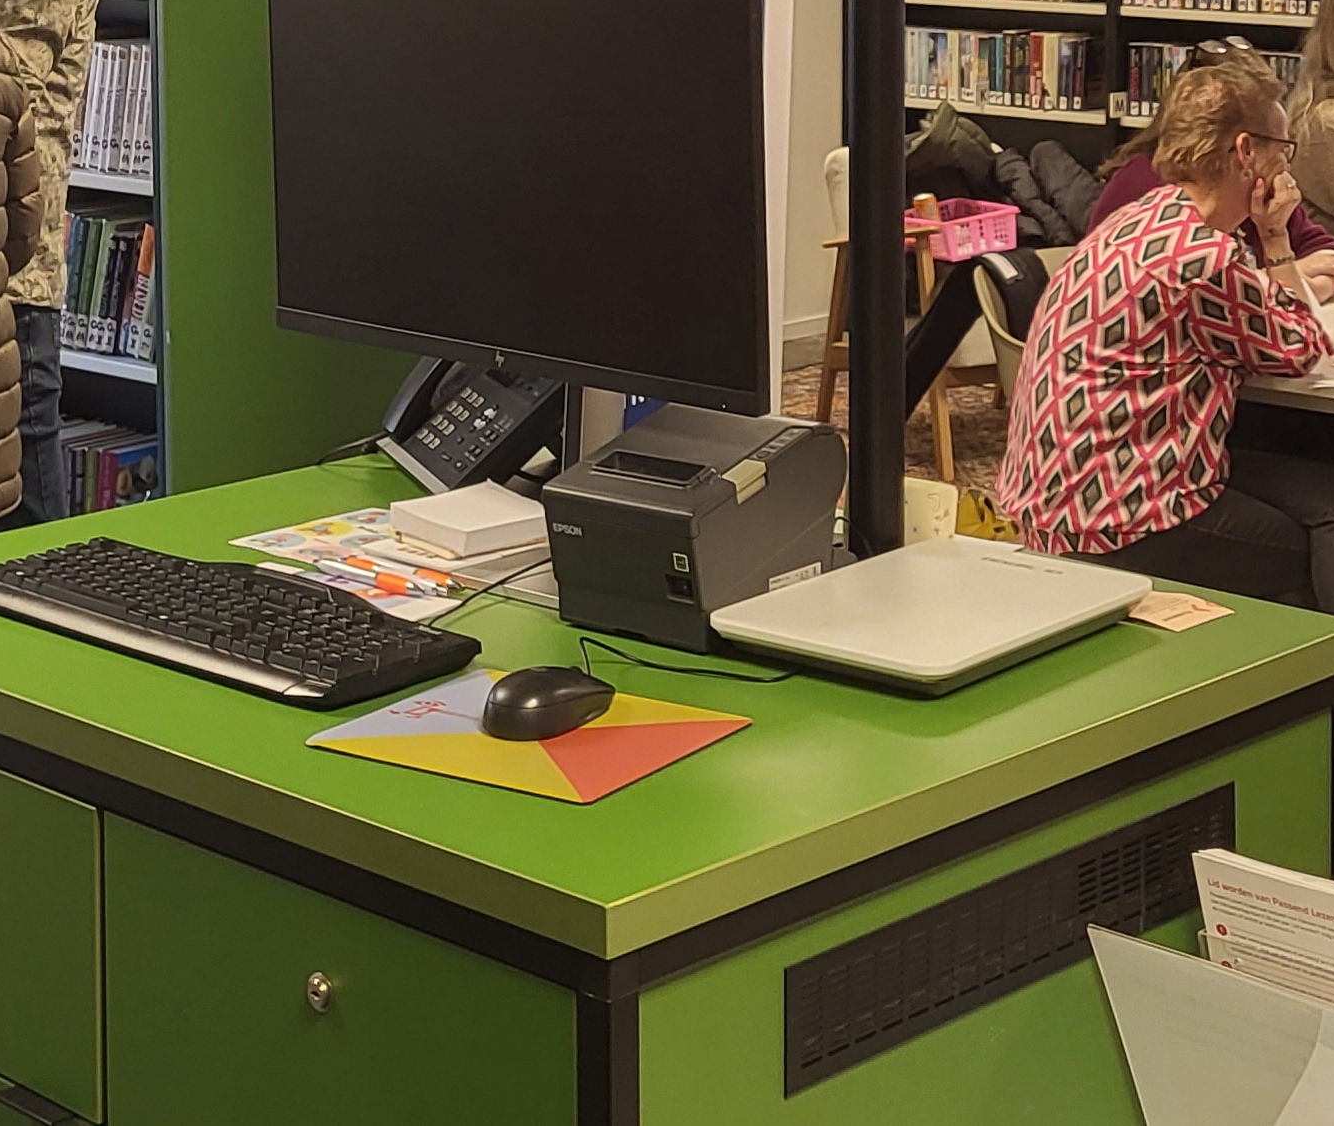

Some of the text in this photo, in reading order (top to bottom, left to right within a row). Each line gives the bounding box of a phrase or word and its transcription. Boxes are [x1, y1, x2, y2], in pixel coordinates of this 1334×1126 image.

[552, 522, 583, 537] EPSON
[1207, 877, 1221, 889] Lid
[1222, 884, 1253, 898] worden
[1255, 893, 1270, 903] van
[1272, 897, 1309, 915] Passend
